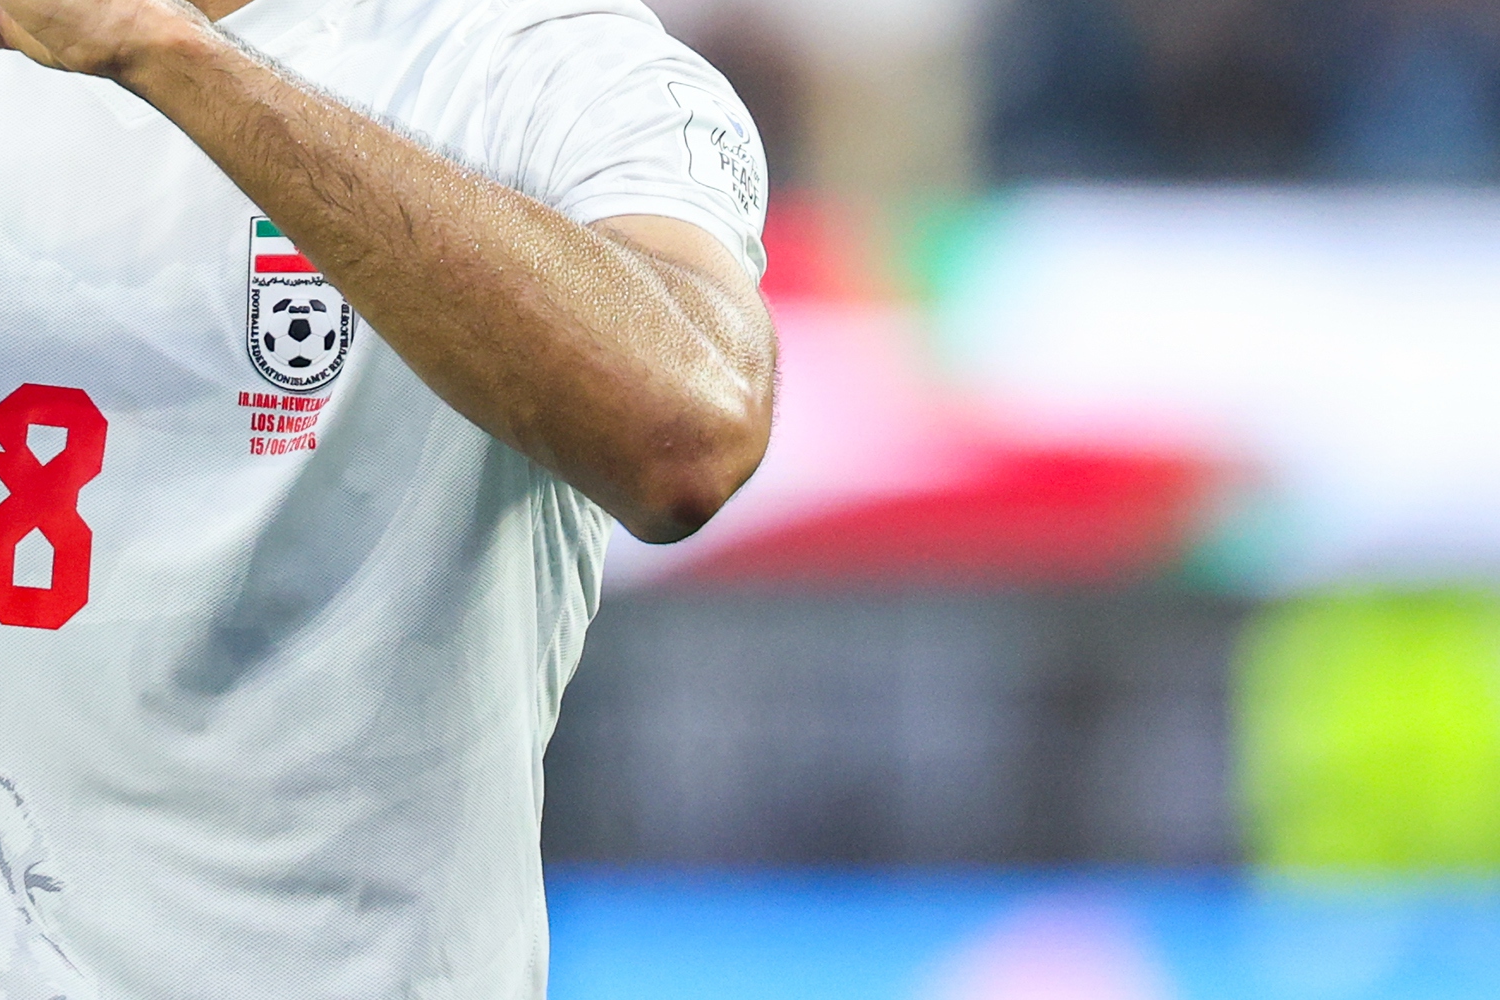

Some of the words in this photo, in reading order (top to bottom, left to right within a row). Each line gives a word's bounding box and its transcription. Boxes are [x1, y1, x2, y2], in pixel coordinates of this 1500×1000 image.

[718, 151, 760, 210] PEACE
[732, 182, 750, 215] FIFA
[251, 289, 260, 337] FOOTBALL
[251, 339, 290, 384] FEDERATION
[251, 413, 275, 433] LOS
[250, 432, 316, 455] 15/06/2026
